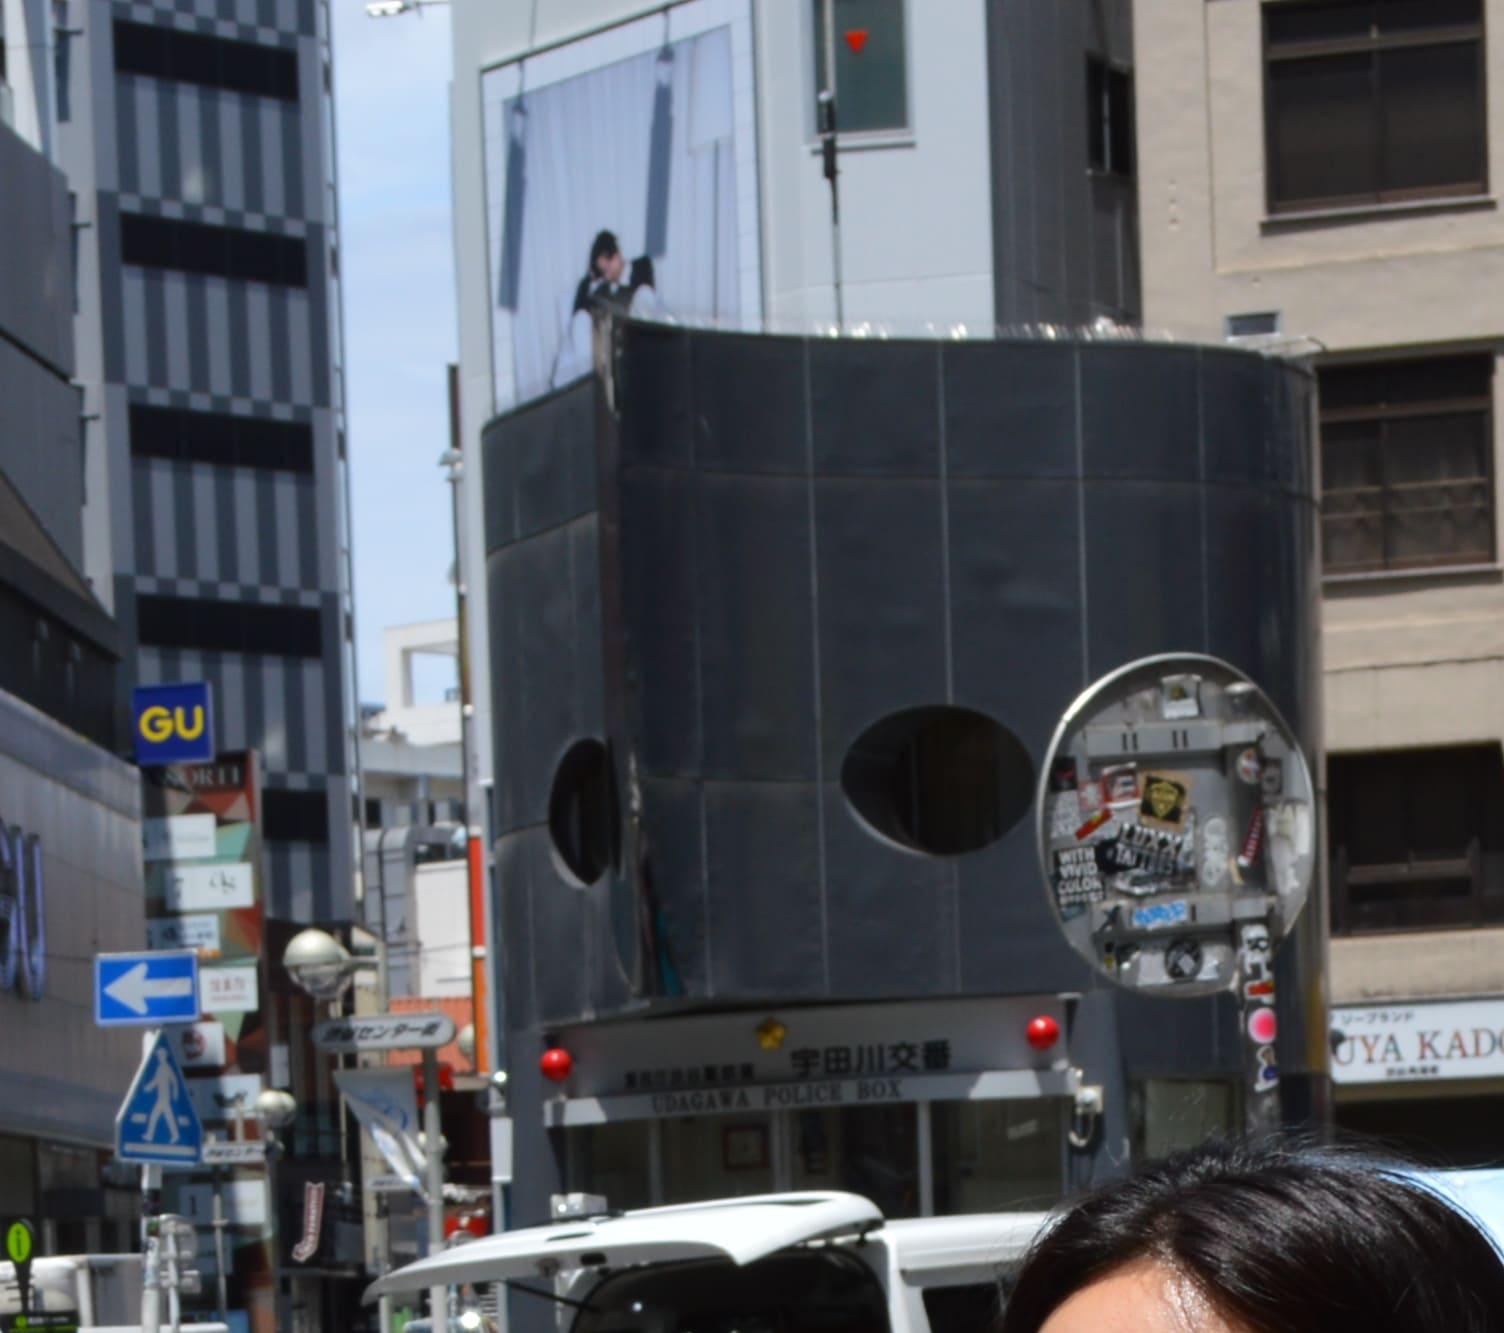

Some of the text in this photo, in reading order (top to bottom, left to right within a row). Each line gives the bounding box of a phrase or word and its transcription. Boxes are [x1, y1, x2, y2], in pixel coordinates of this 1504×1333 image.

[140, 705, 205, 742] GU
[790, 1040, 950, 1077] 宇田川交番
[652, 1079, 903, 1115] UDAGAWA POLICE BOX
